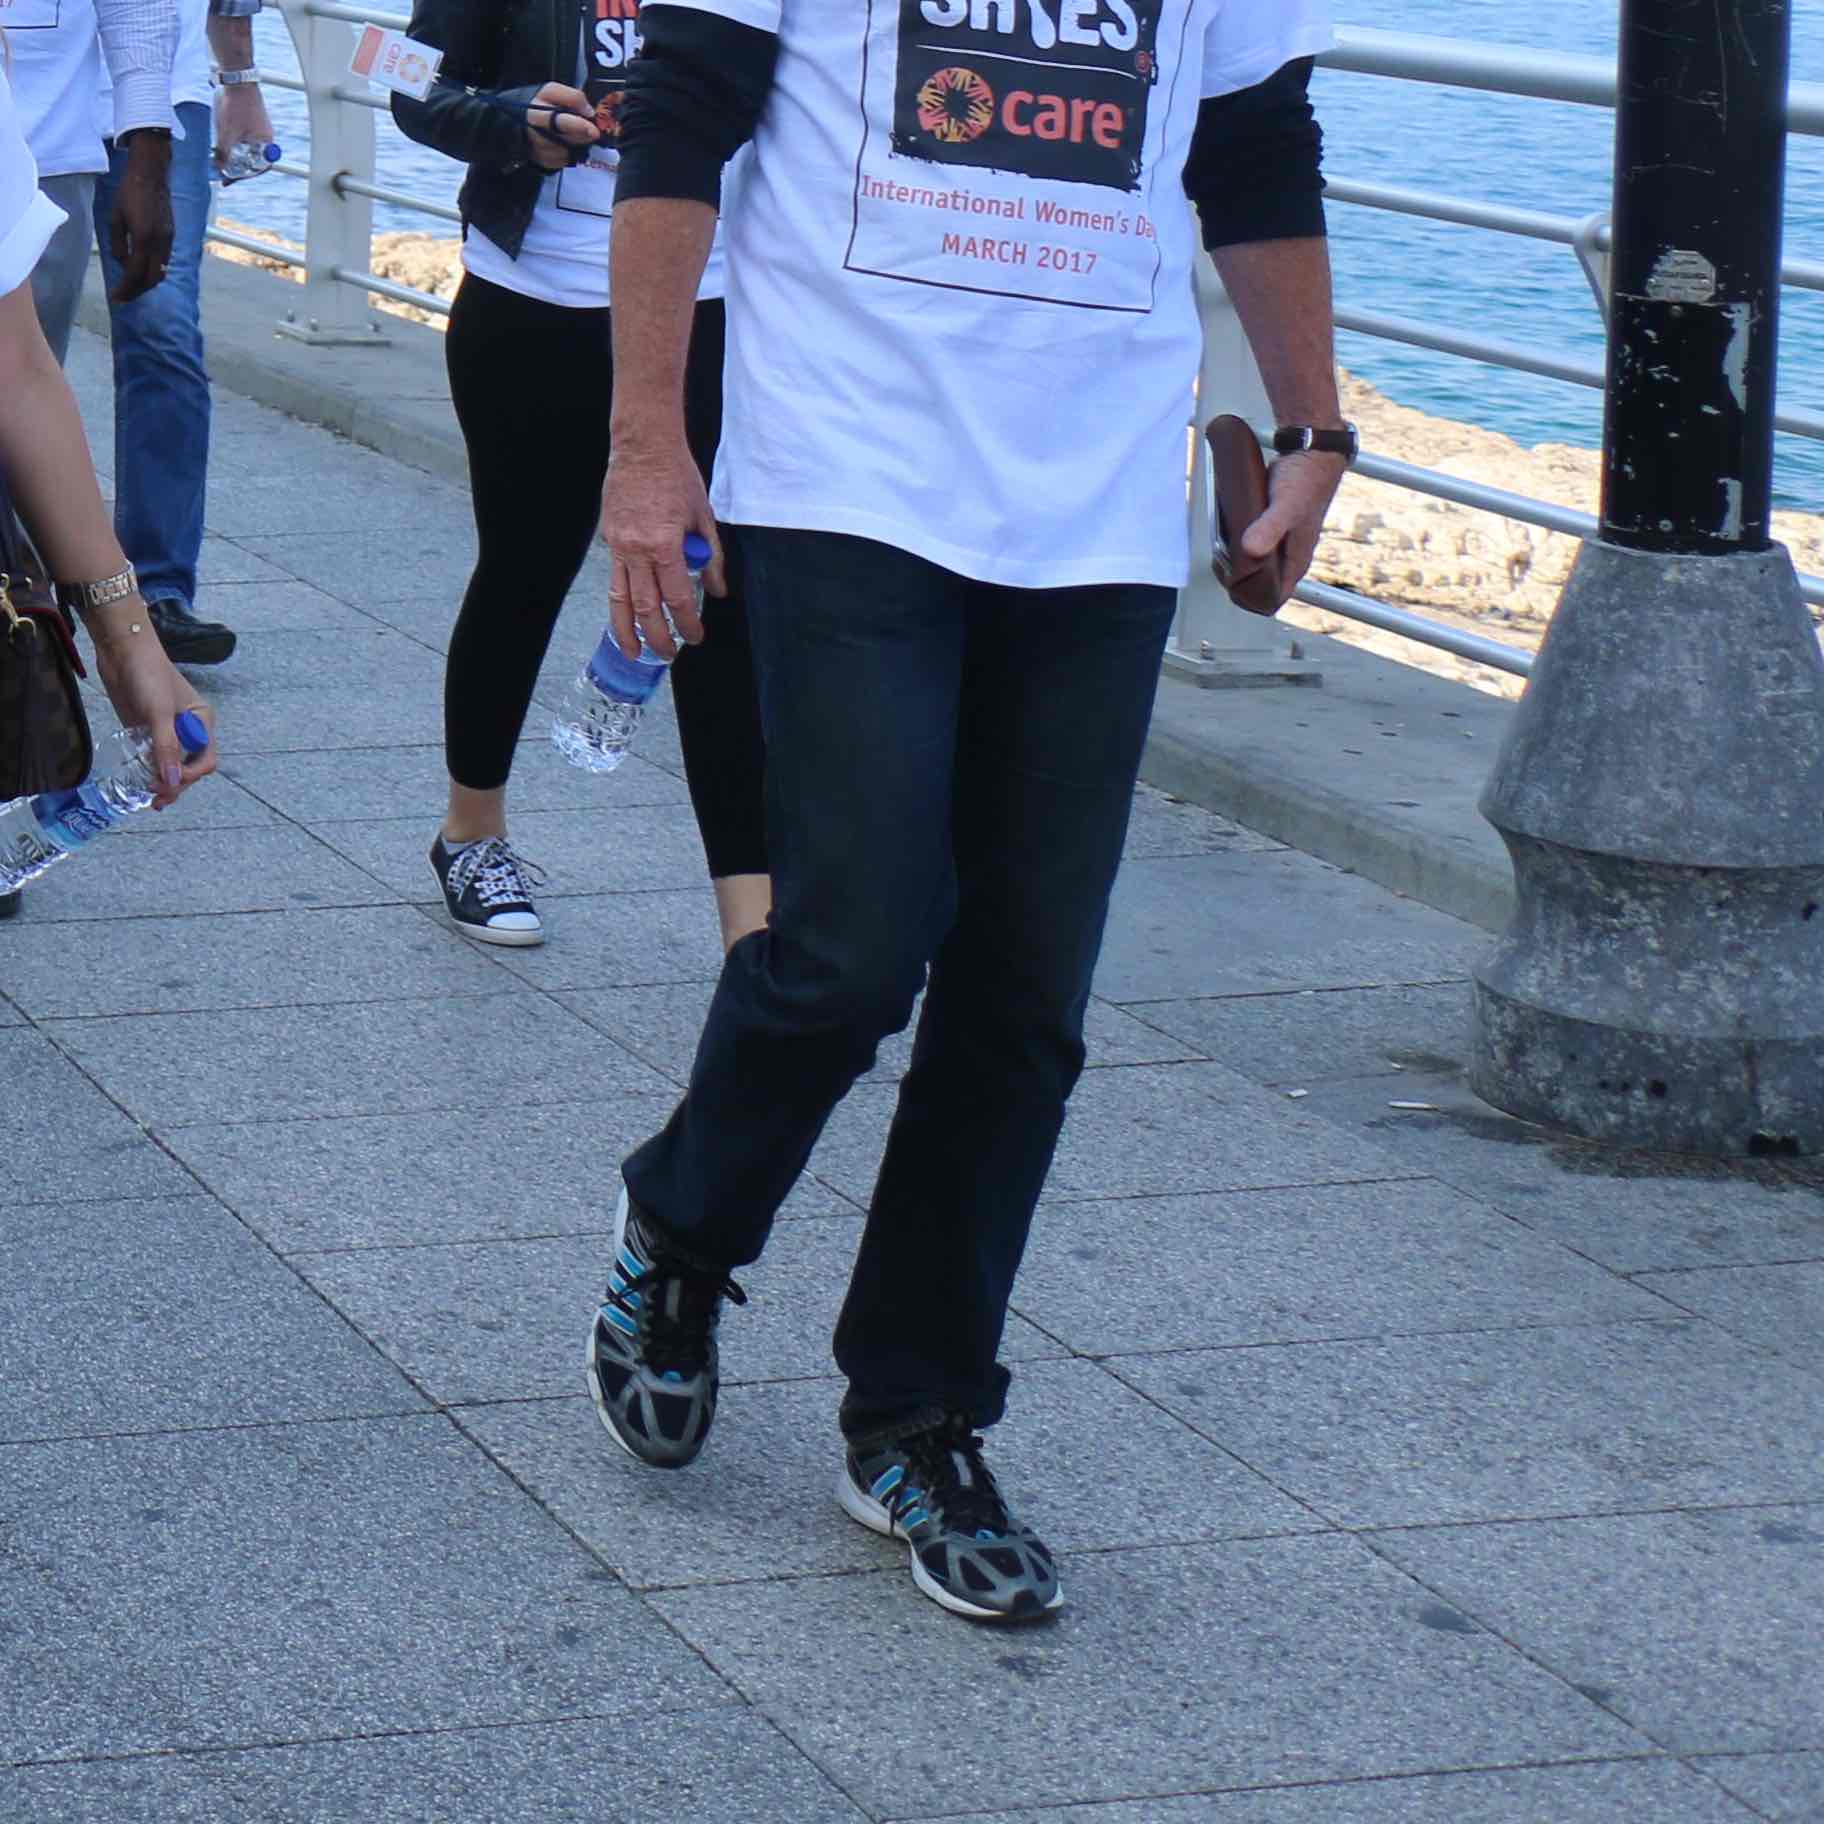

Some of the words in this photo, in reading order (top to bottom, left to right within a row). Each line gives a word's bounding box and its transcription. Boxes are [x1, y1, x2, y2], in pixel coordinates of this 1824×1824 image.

[1001, 90, 1124, 149] care
[860, 174, 1026, 222] International
[1034, 198, 1130, 237] Women's
[940, 232, 1028, 267] MARCH
[1037, 246, 1098, 276] 2017
